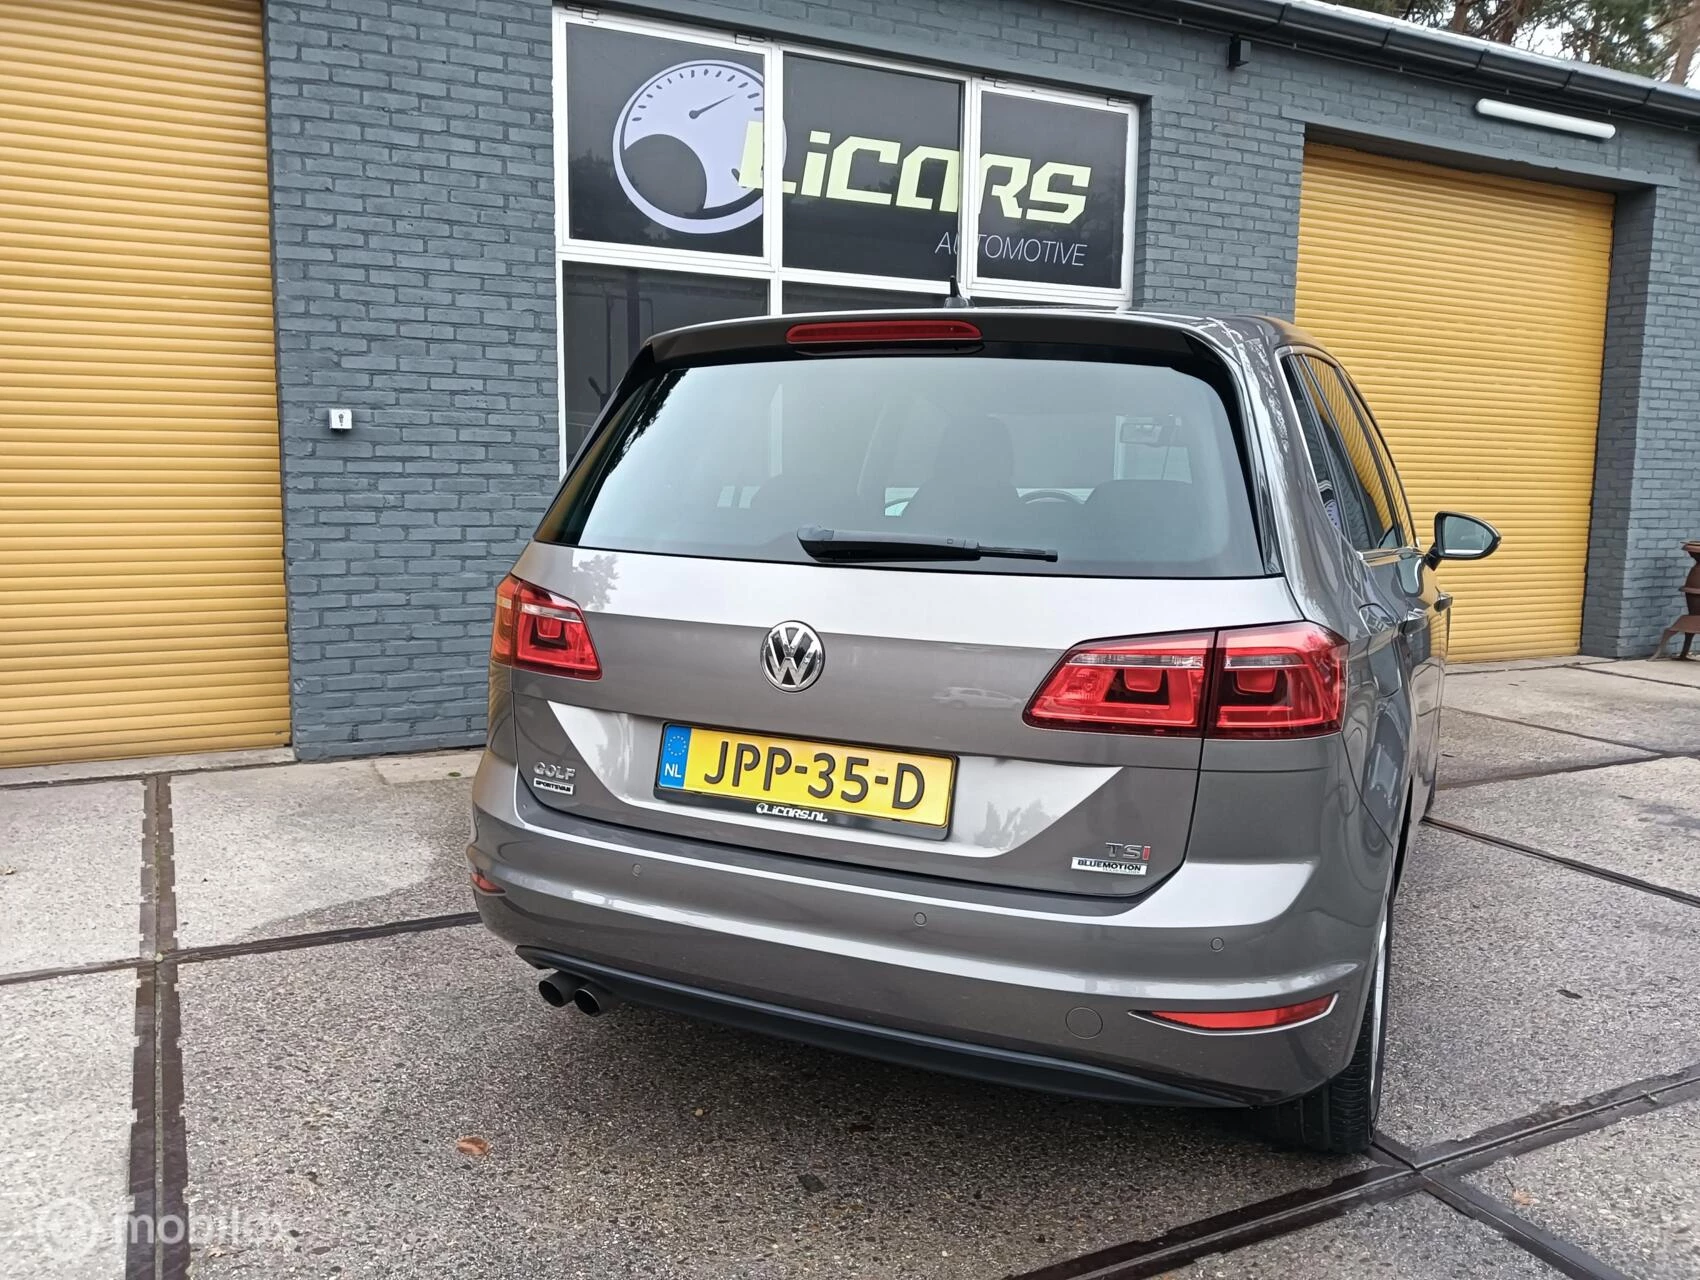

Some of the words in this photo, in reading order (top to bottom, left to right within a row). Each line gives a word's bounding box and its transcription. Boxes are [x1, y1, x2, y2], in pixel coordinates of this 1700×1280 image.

[533, 761, 576, 780] GOLF
[664, 762, 682, 779] NL
[703, 740, 926, 810] JPP-35-D
